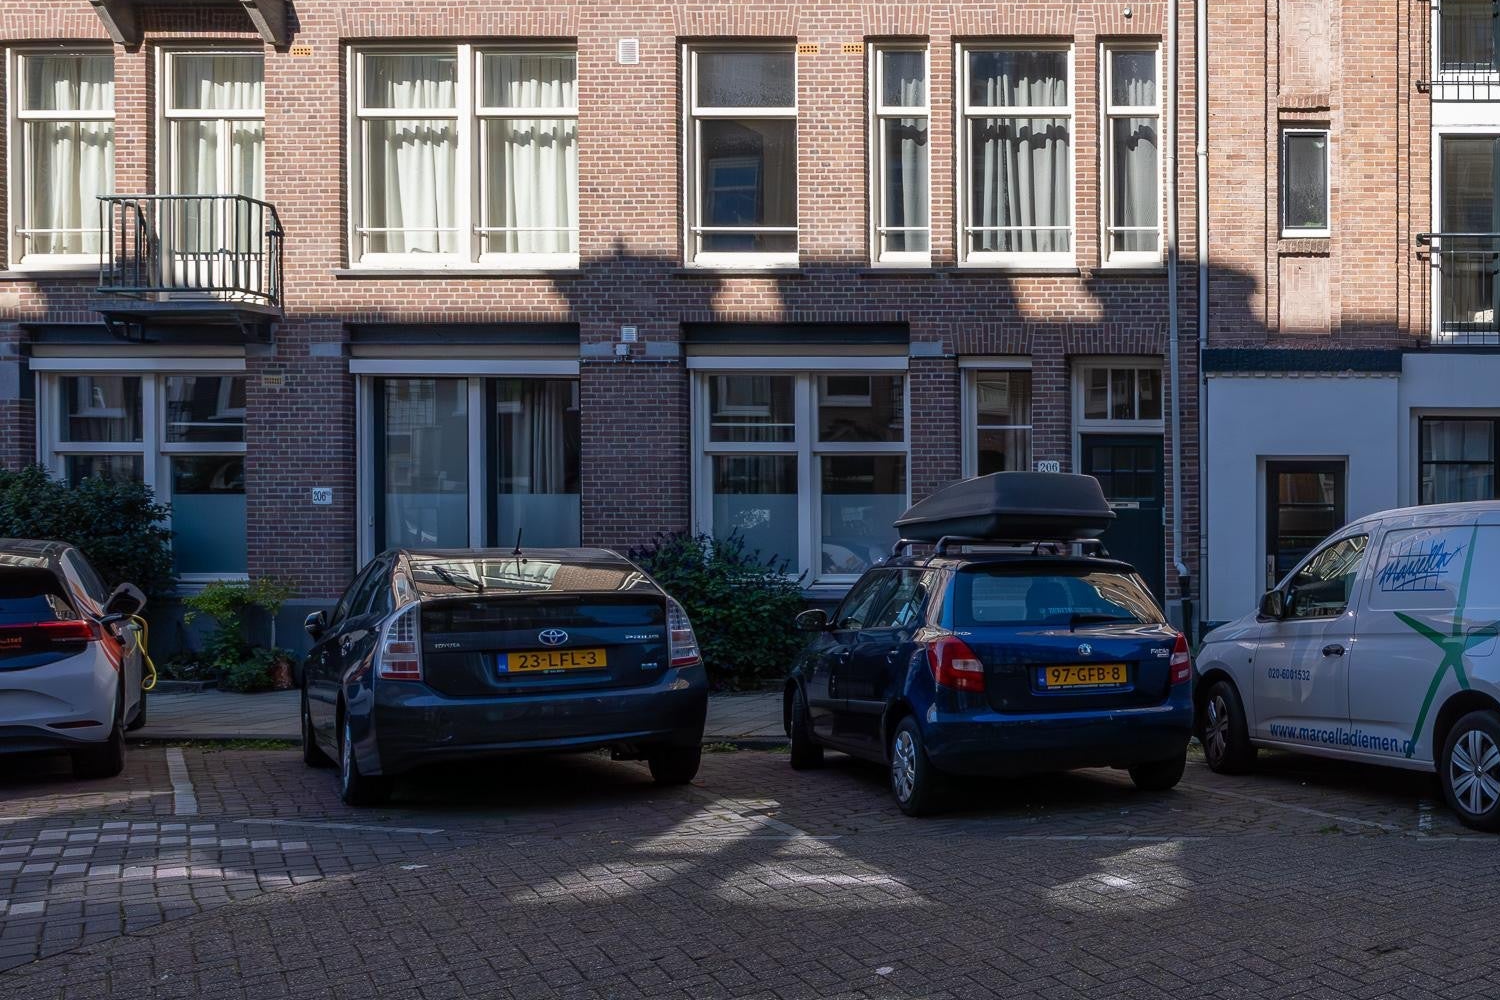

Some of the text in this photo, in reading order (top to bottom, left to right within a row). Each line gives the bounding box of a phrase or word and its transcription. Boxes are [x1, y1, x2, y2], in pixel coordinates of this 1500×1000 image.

[1040, 462, 1058, 473] 206
[518, 651, 597, 669] 23-LFL-3
[1051, 667, 1120, 683] 97-GFB-8
[1267, 667, 1311, 681] 020-6001532
